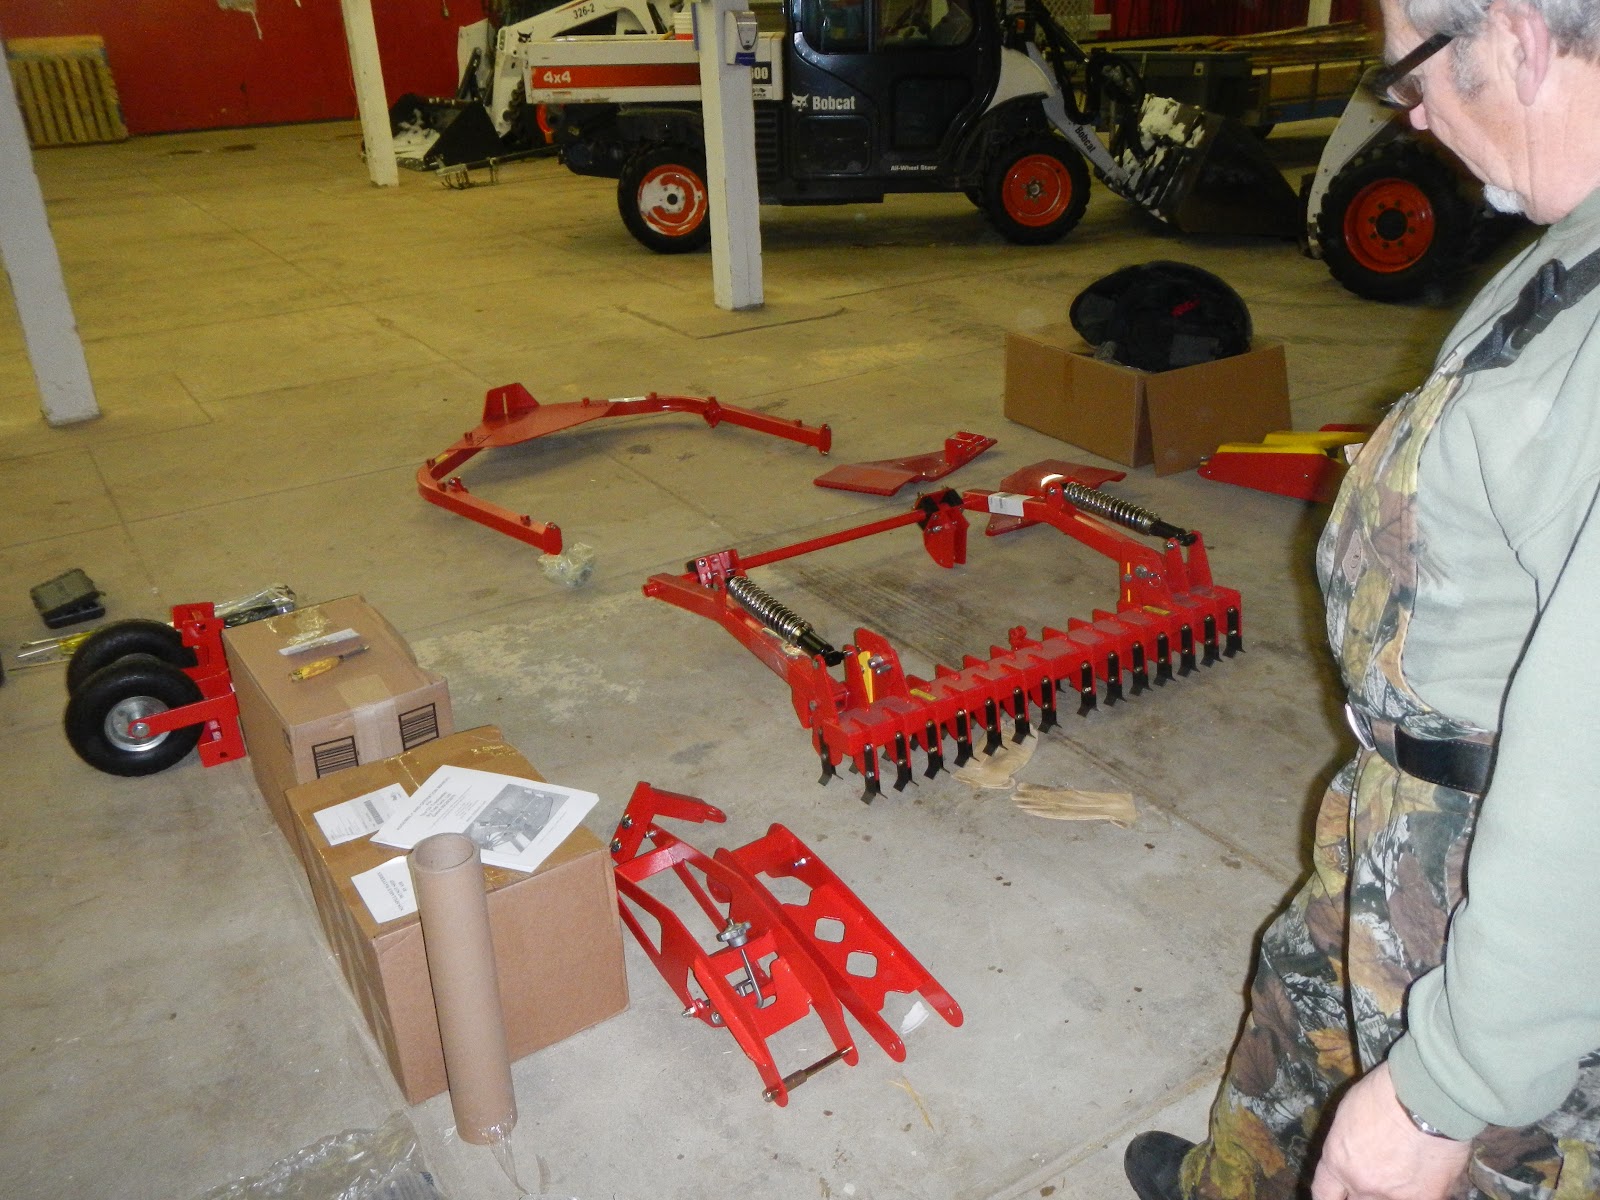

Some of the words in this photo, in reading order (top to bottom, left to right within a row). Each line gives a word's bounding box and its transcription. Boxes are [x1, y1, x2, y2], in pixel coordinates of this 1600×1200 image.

[573, 3, 595, 19] 326-2
[543, 71, 571, 83] 4x4
[812, 95, 855, 110] Bobcat
[1075, 126, 1096, 152] Bobcat
